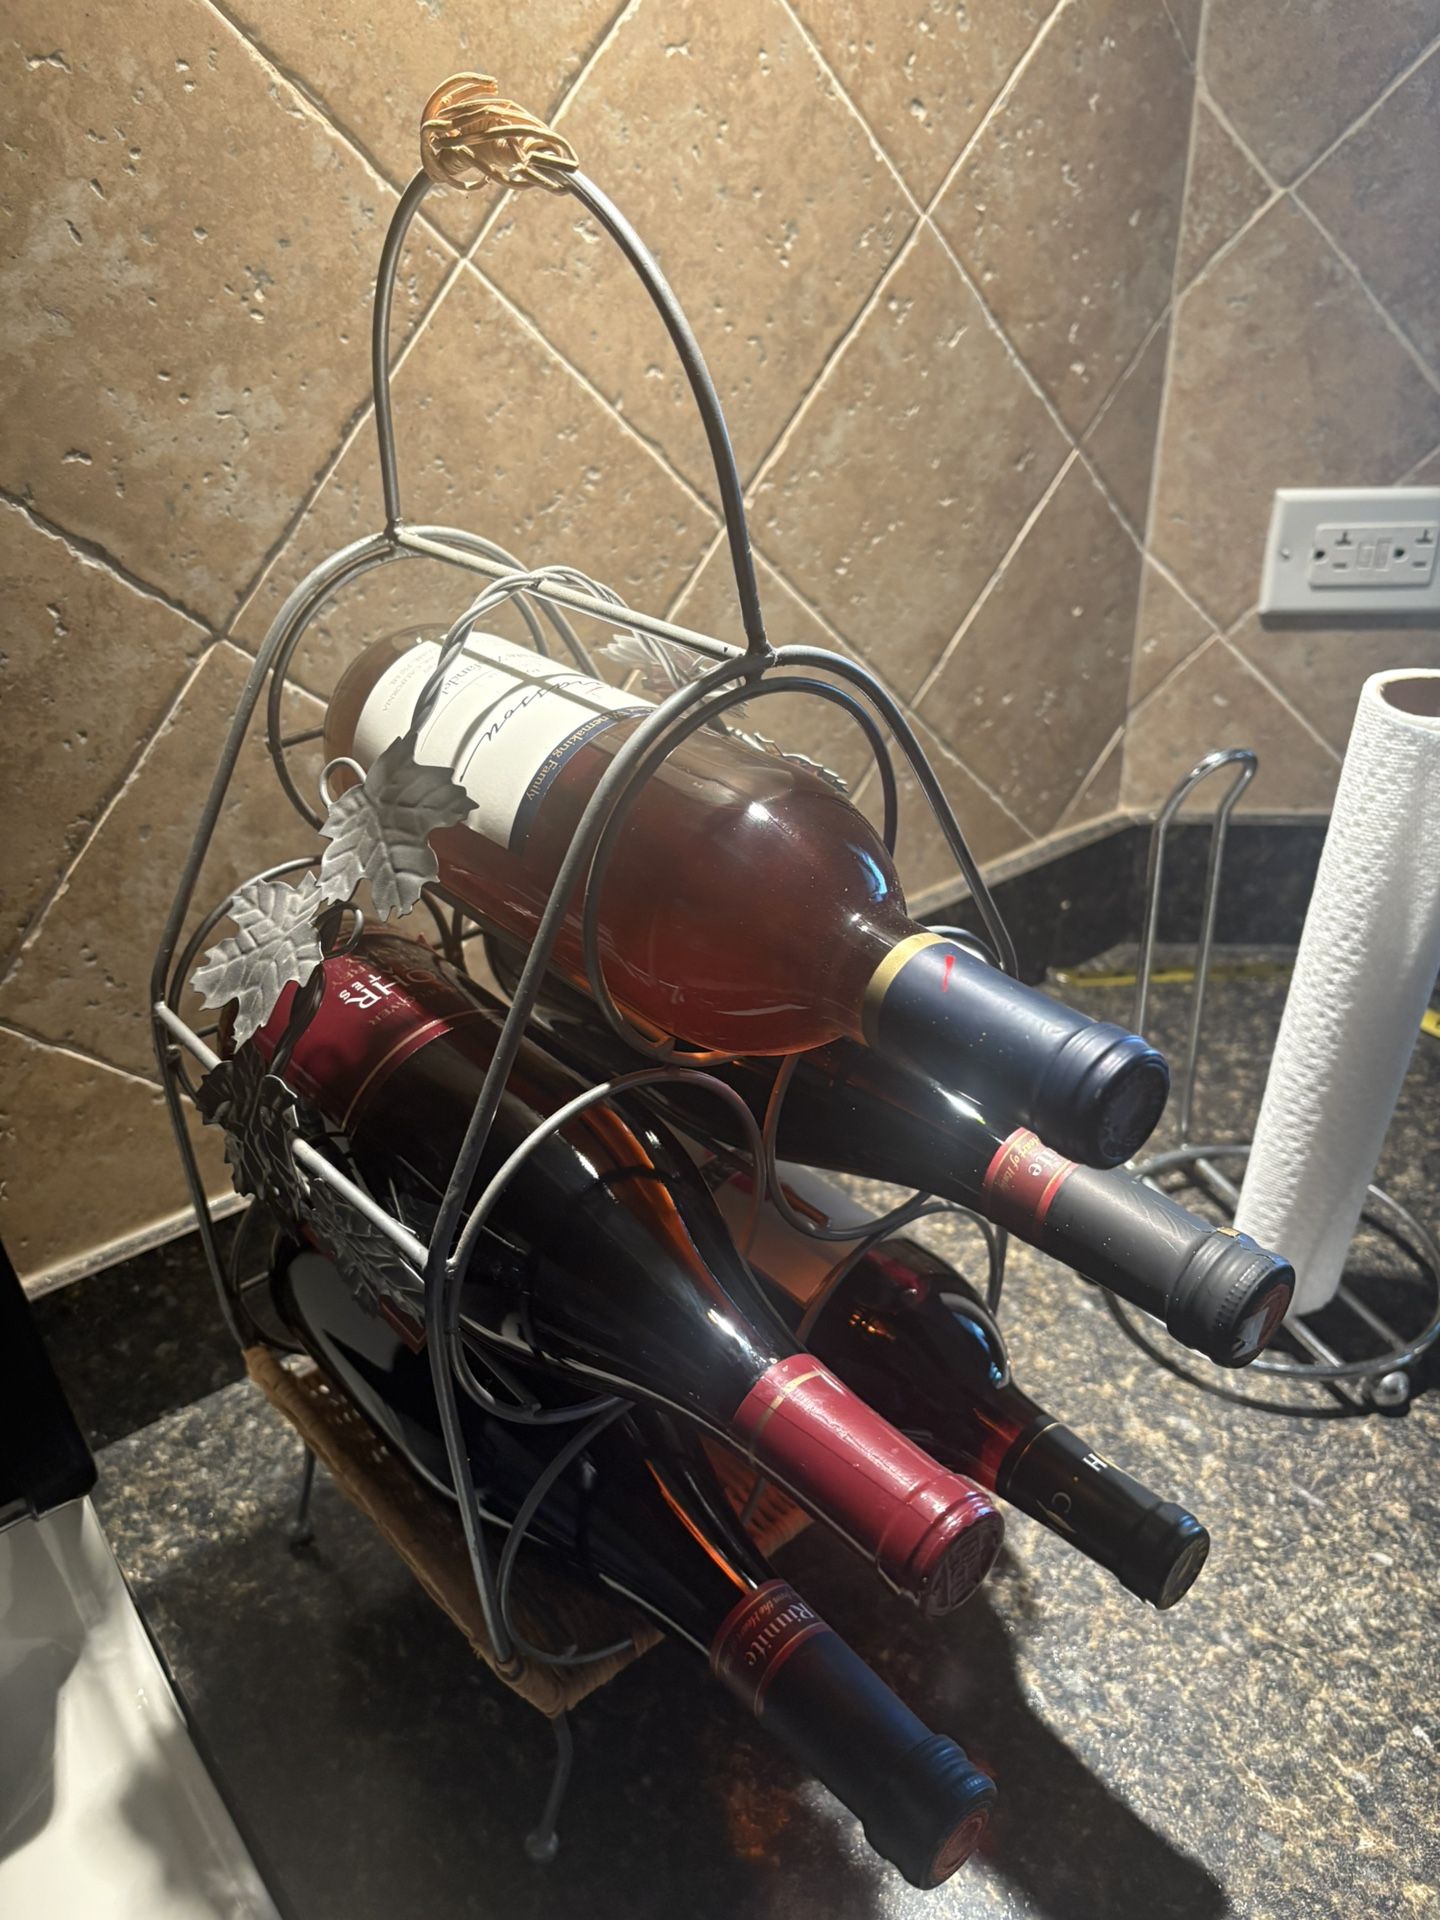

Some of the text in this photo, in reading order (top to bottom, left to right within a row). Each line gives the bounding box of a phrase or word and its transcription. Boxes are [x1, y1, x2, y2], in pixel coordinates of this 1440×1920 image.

[526, 757, 561, 801] Family
[1009, 1154, 1020, 1171] of
[1082, 1452, 1108, 1472] H
[758, 1600, 775, 1615] the
[745, 1602, 815, 1667] Riunite
